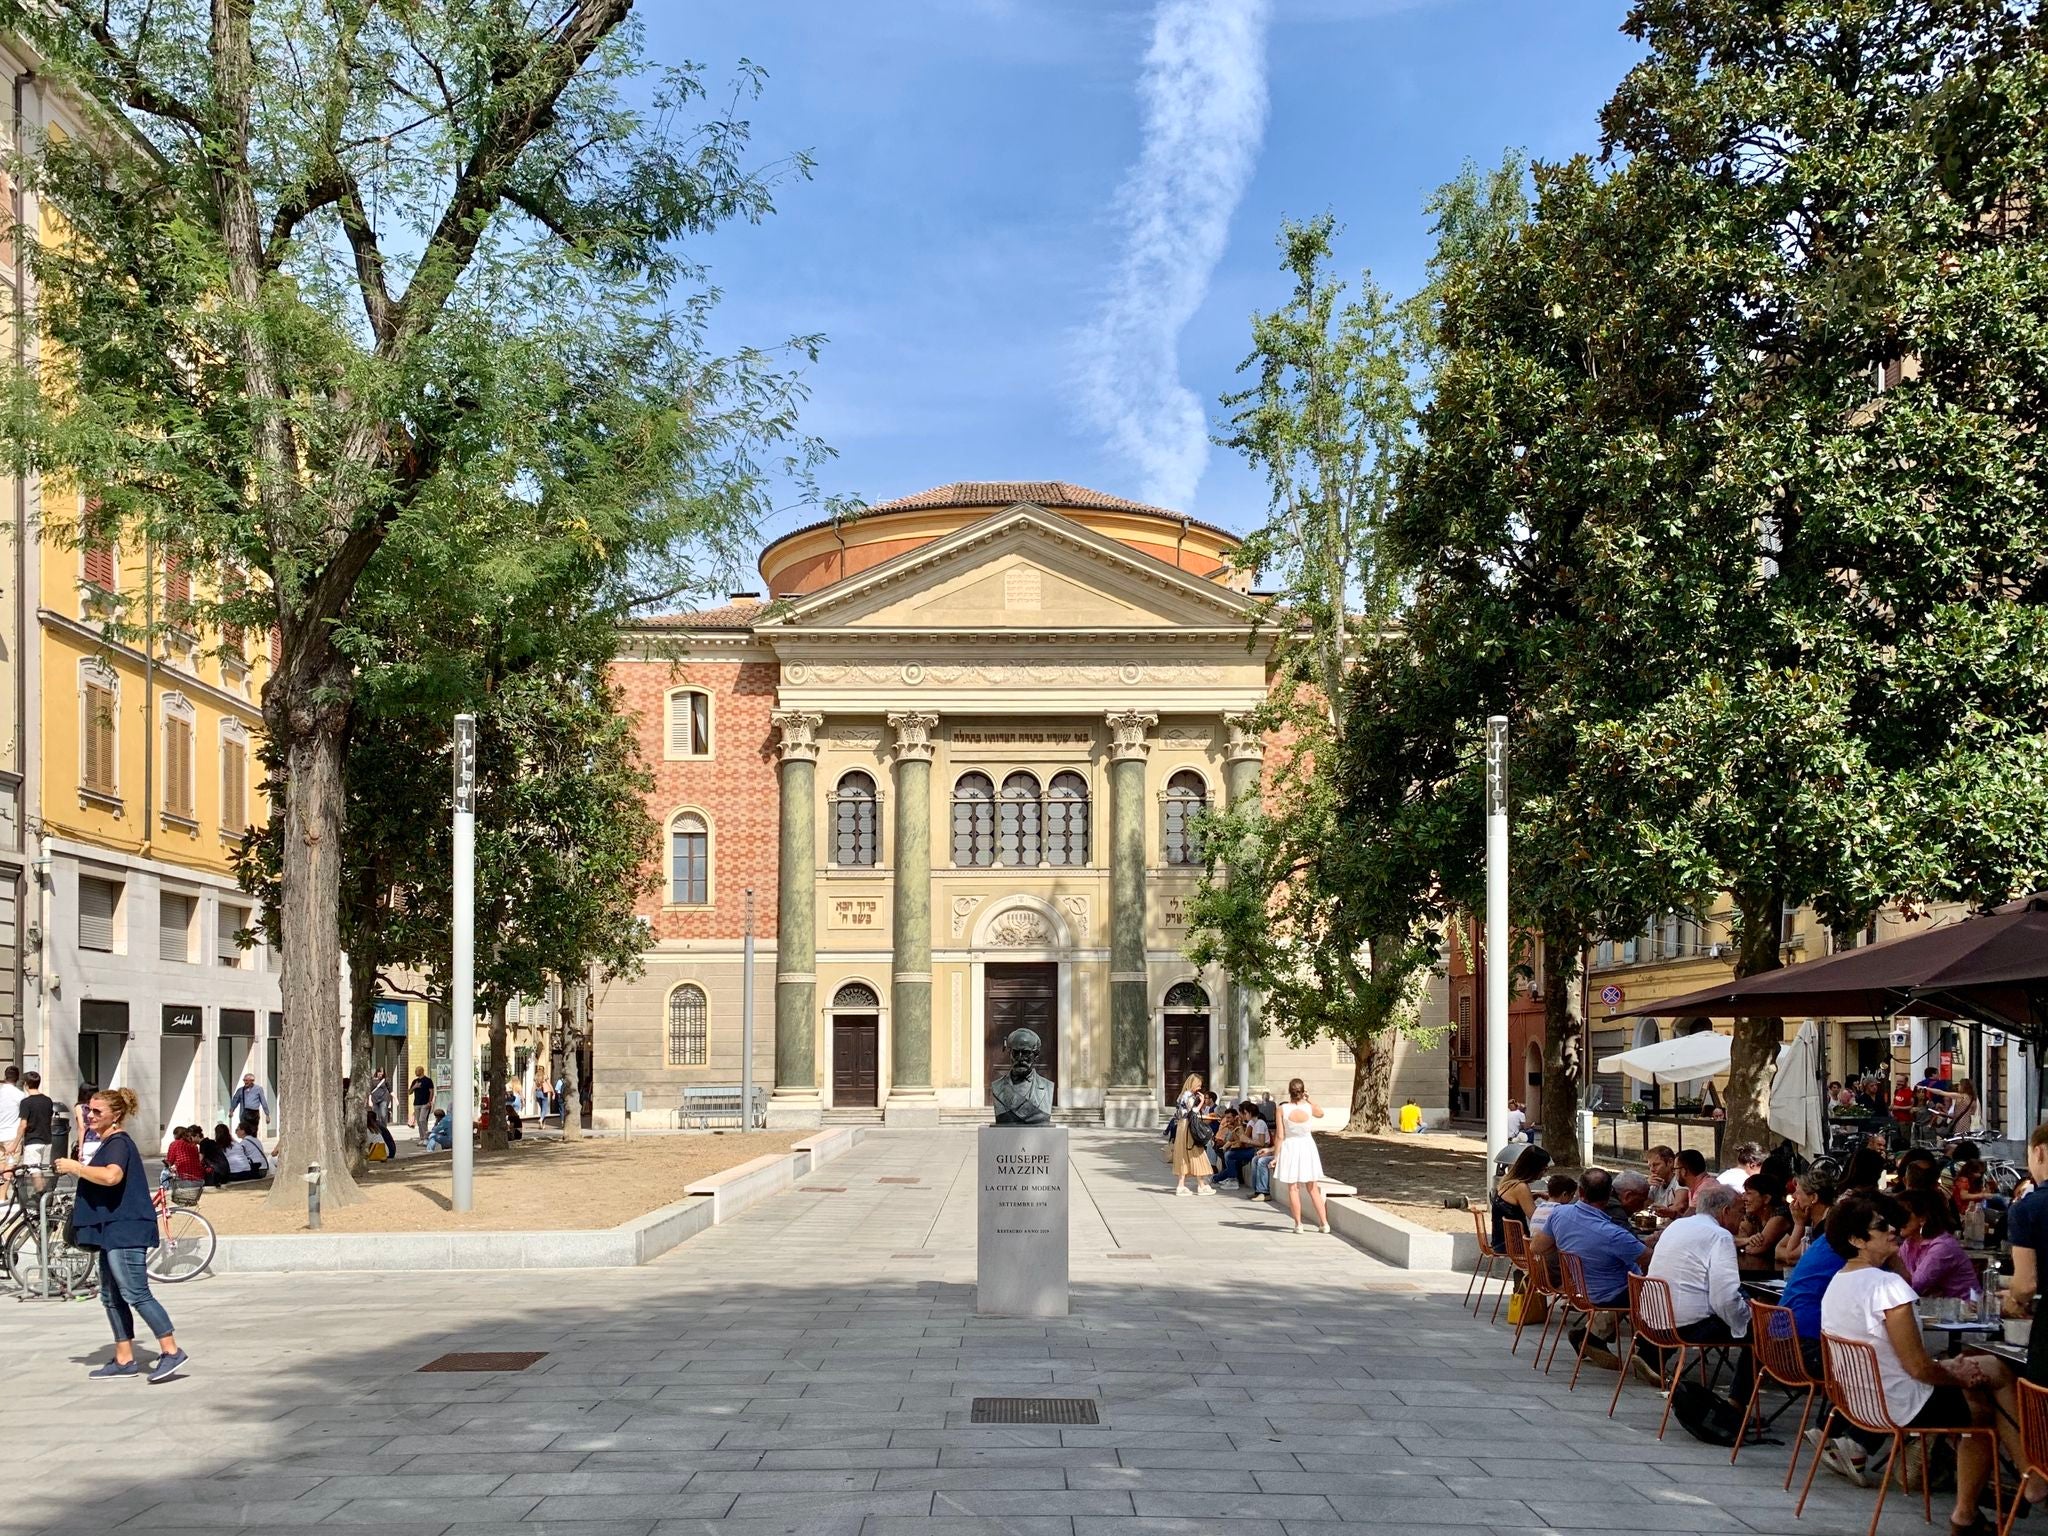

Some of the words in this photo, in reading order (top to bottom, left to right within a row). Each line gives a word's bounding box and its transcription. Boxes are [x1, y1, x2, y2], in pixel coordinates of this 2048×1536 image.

[835, 901, 854, 912] הבא
[856, 901, 877, 914] ברוך
[851, 913, 872, 925] בשם
[996, 1154, 1050, 1164] GIUSEPPE
[997, 1166, 1049, 1175] MAZZINI
